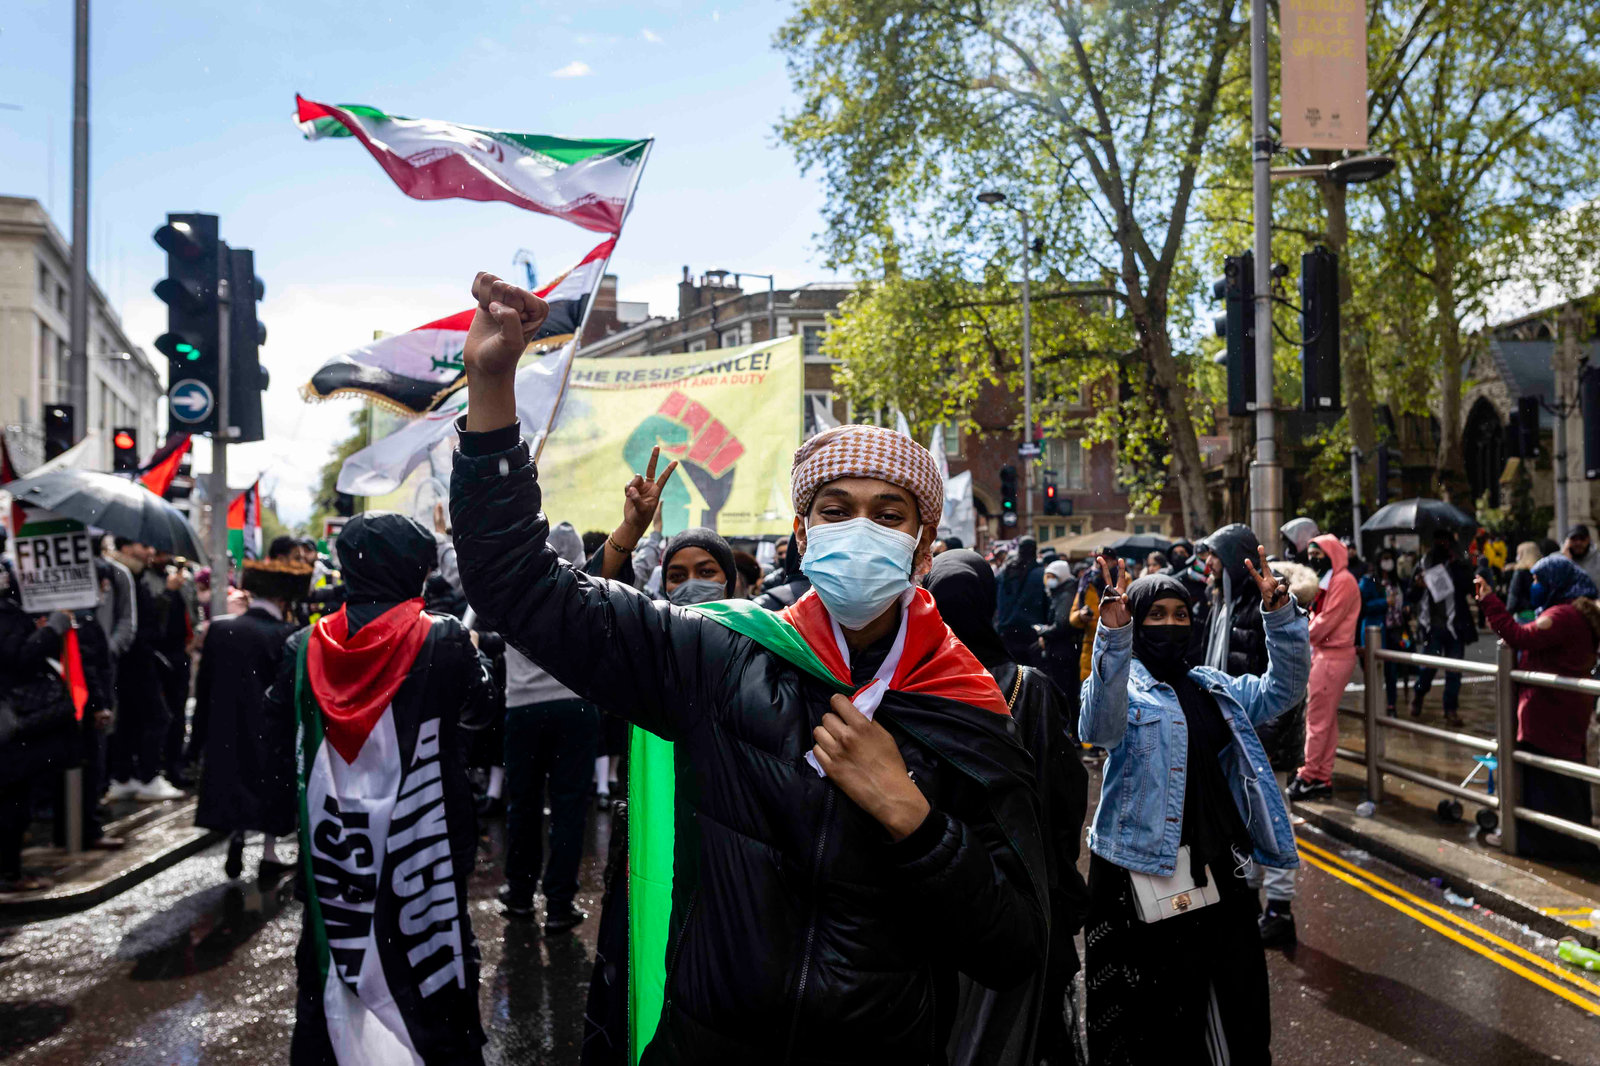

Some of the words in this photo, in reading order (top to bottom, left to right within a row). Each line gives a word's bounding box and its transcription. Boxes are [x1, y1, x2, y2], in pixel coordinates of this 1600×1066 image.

[1297, 16, 1349, 35] FACE
[1292, 39, 1355, 57] SPACE
[692, 376, 718, 388] AND
[720, 375, 727, 385] A
[731, 373, 765, 385] DUTY
[16, 535, 89, 569] FREE
[20, 567, 91, 583] PALESTINE
[313, 795, 378, 997] ISRAE
